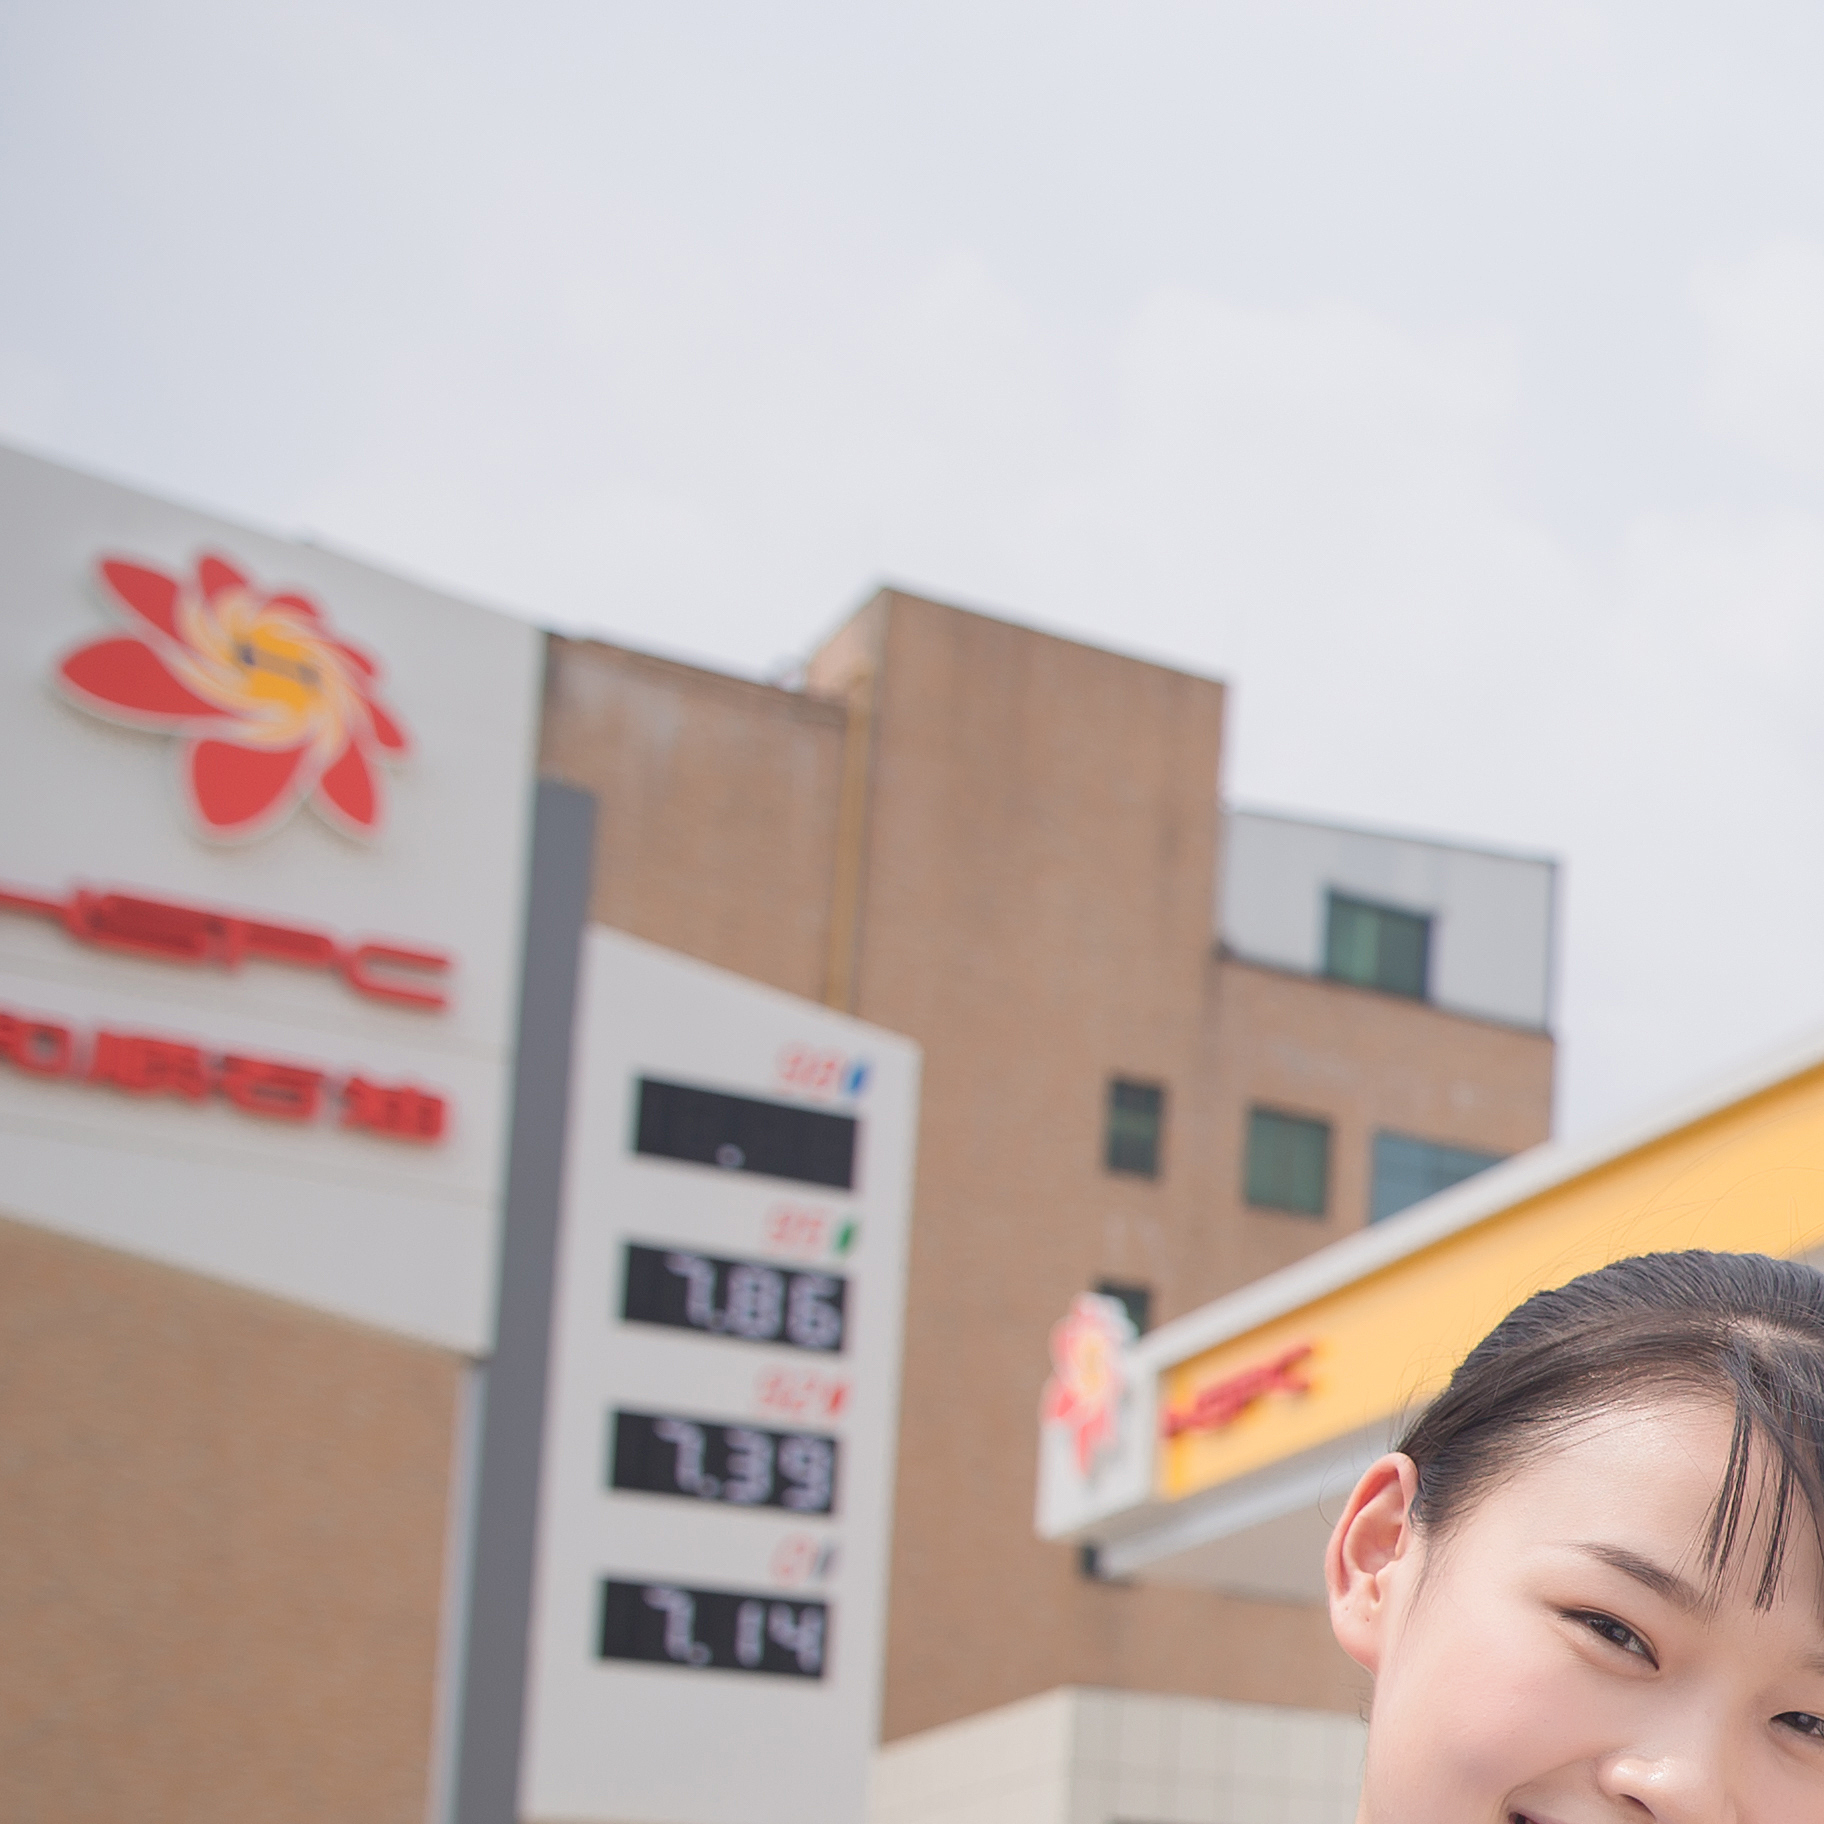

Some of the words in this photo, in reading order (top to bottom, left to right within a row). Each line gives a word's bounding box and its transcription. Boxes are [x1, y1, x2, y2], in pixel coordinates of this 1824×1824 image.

[662, 1251, 844, 1351] 7.86
[653, 1416, 836, 1512] 7.39
[642, 1585, 824, 1674] 7.14
